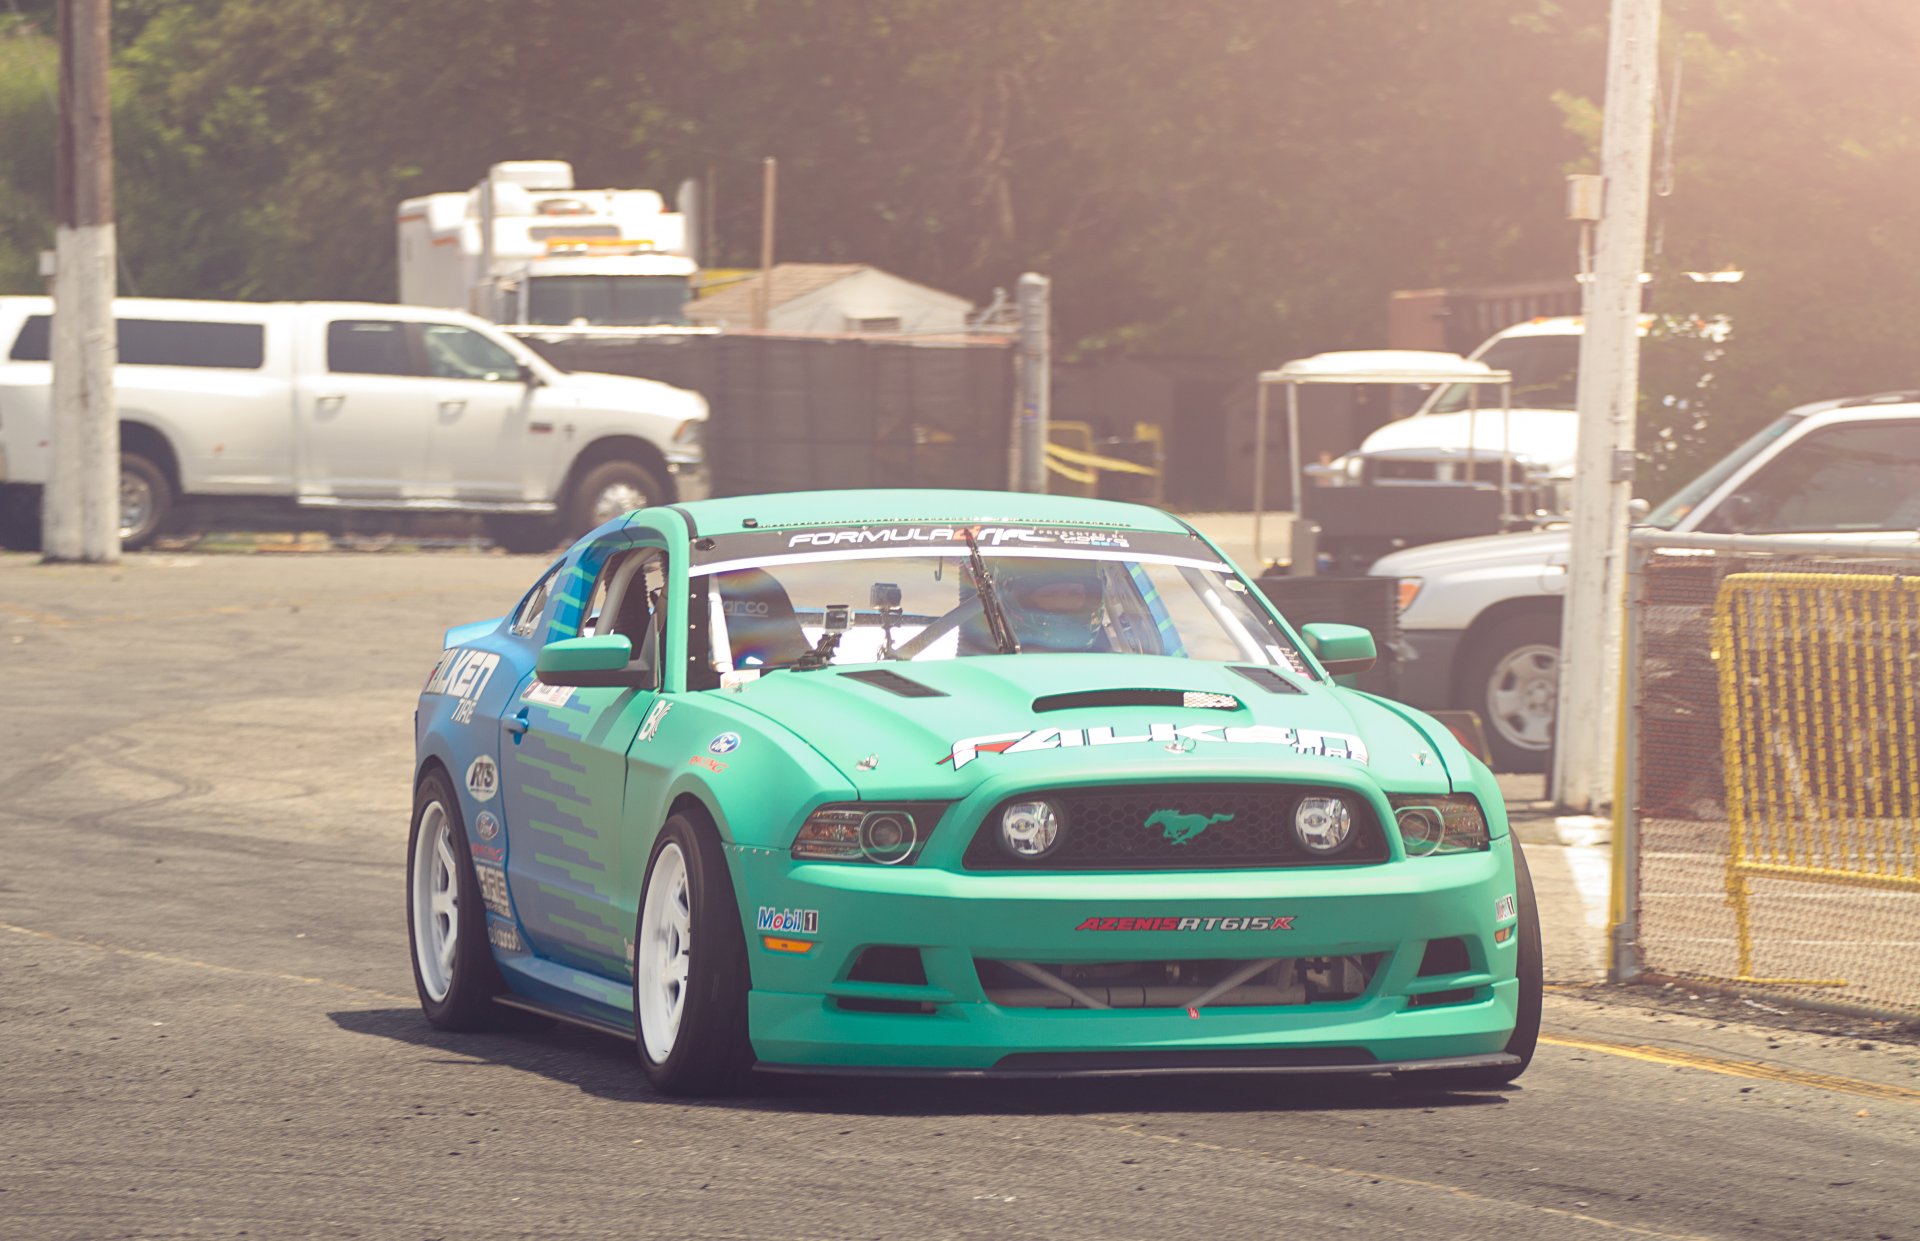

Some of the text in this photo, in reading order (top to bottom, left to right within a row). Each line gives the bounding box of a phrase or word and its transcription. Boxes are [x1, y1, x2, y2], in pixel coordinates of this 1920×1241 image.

[788, 528, 954, 548] FORMULA
[450, 698, 477, 725] TIRE
[470, 762, 495, 788] RTS
[757, 906, 803, 932] Mobil
